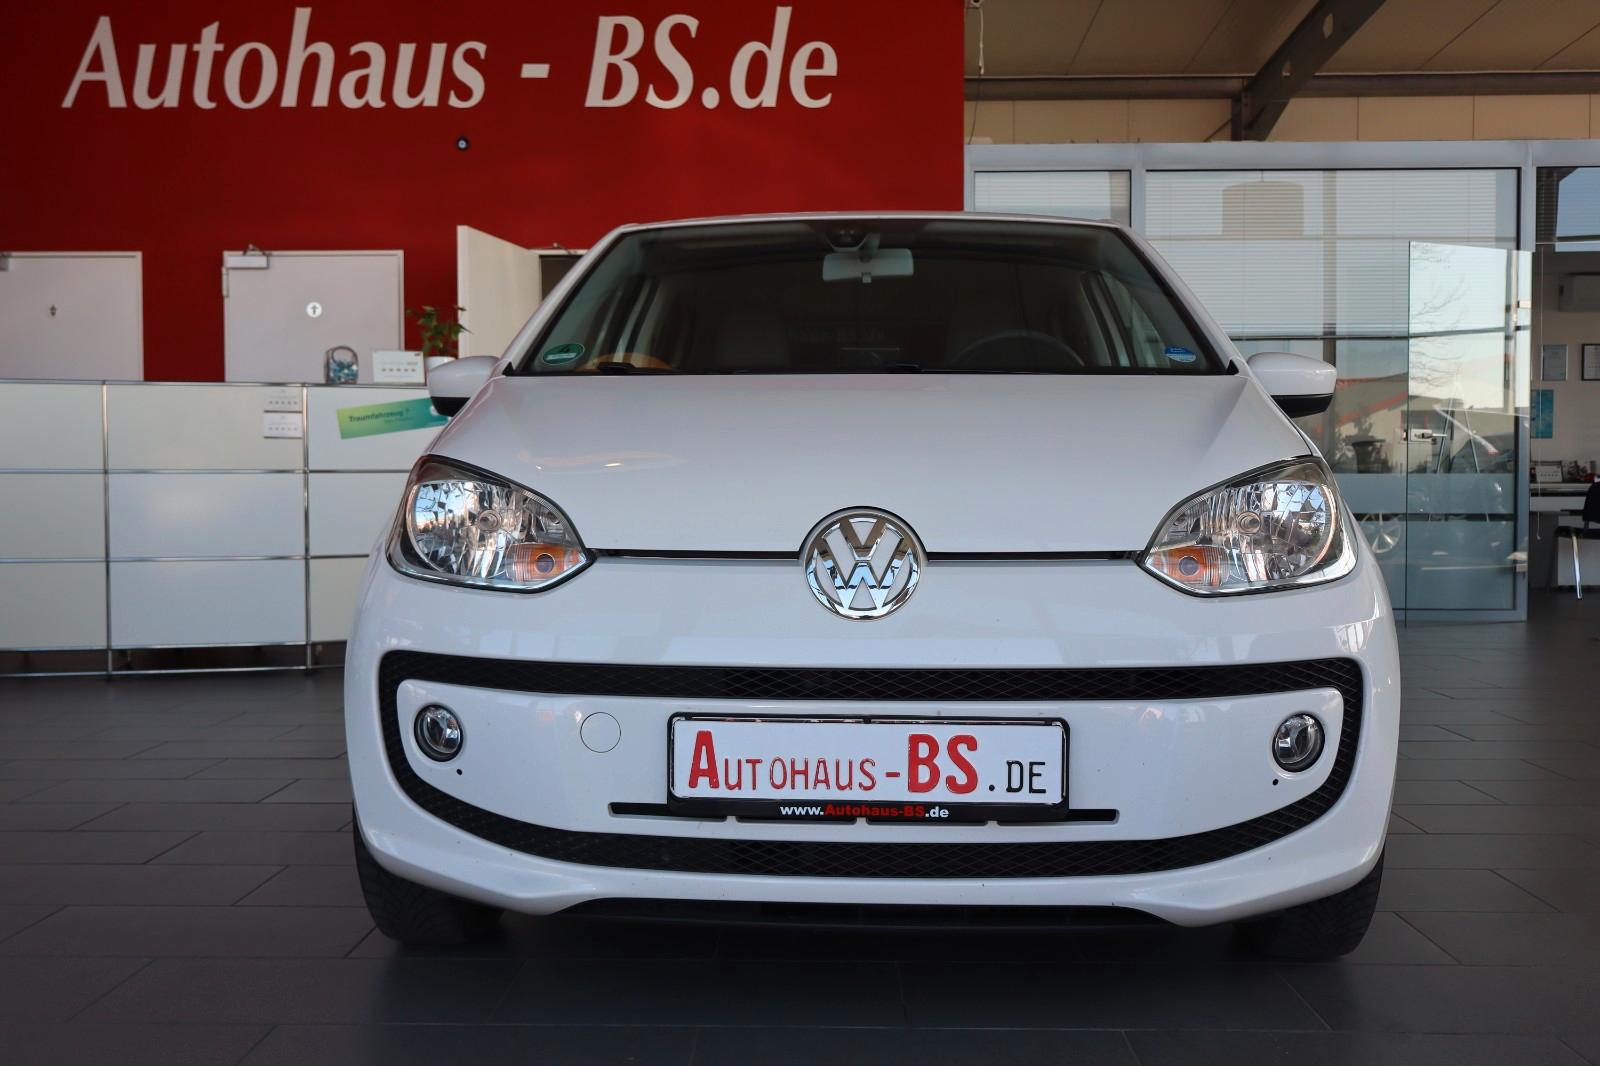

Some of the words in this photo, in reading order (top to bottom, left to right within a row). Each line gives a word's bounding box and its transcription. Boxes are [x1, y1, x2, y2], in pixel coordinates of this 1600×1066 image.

[63, 8, 487, 109] Autohaus
[585, 7, 838, 109] BS.de
[779, 804, 950, 819] www.Autohaus-BS.de
